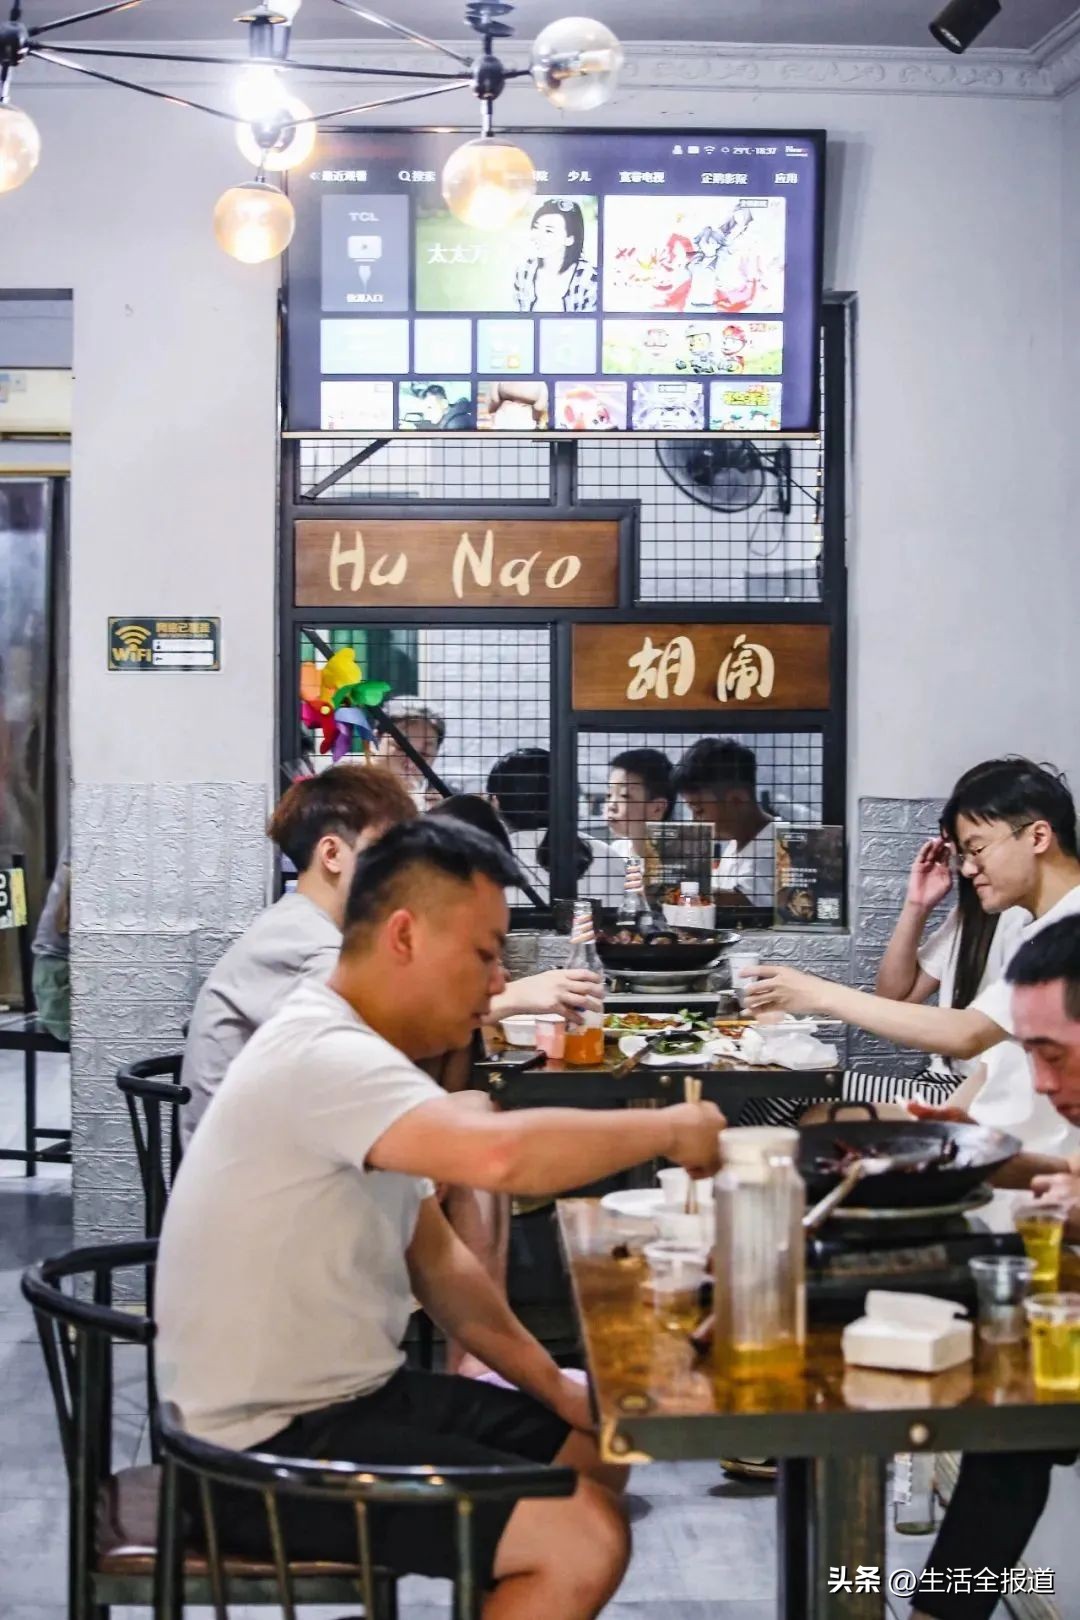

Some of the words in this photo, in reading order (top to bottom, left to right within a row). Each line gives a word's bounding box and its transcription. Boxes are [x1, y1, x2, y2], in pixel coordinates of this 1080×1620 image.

[567, 170, 592, 182] 少儿
[349, 211, 380, 222] TCL
[328, 530, 408, 592] Hu
[452, 528, 583, 600] Nao
[626, 634, 775, 703] 胡闹
